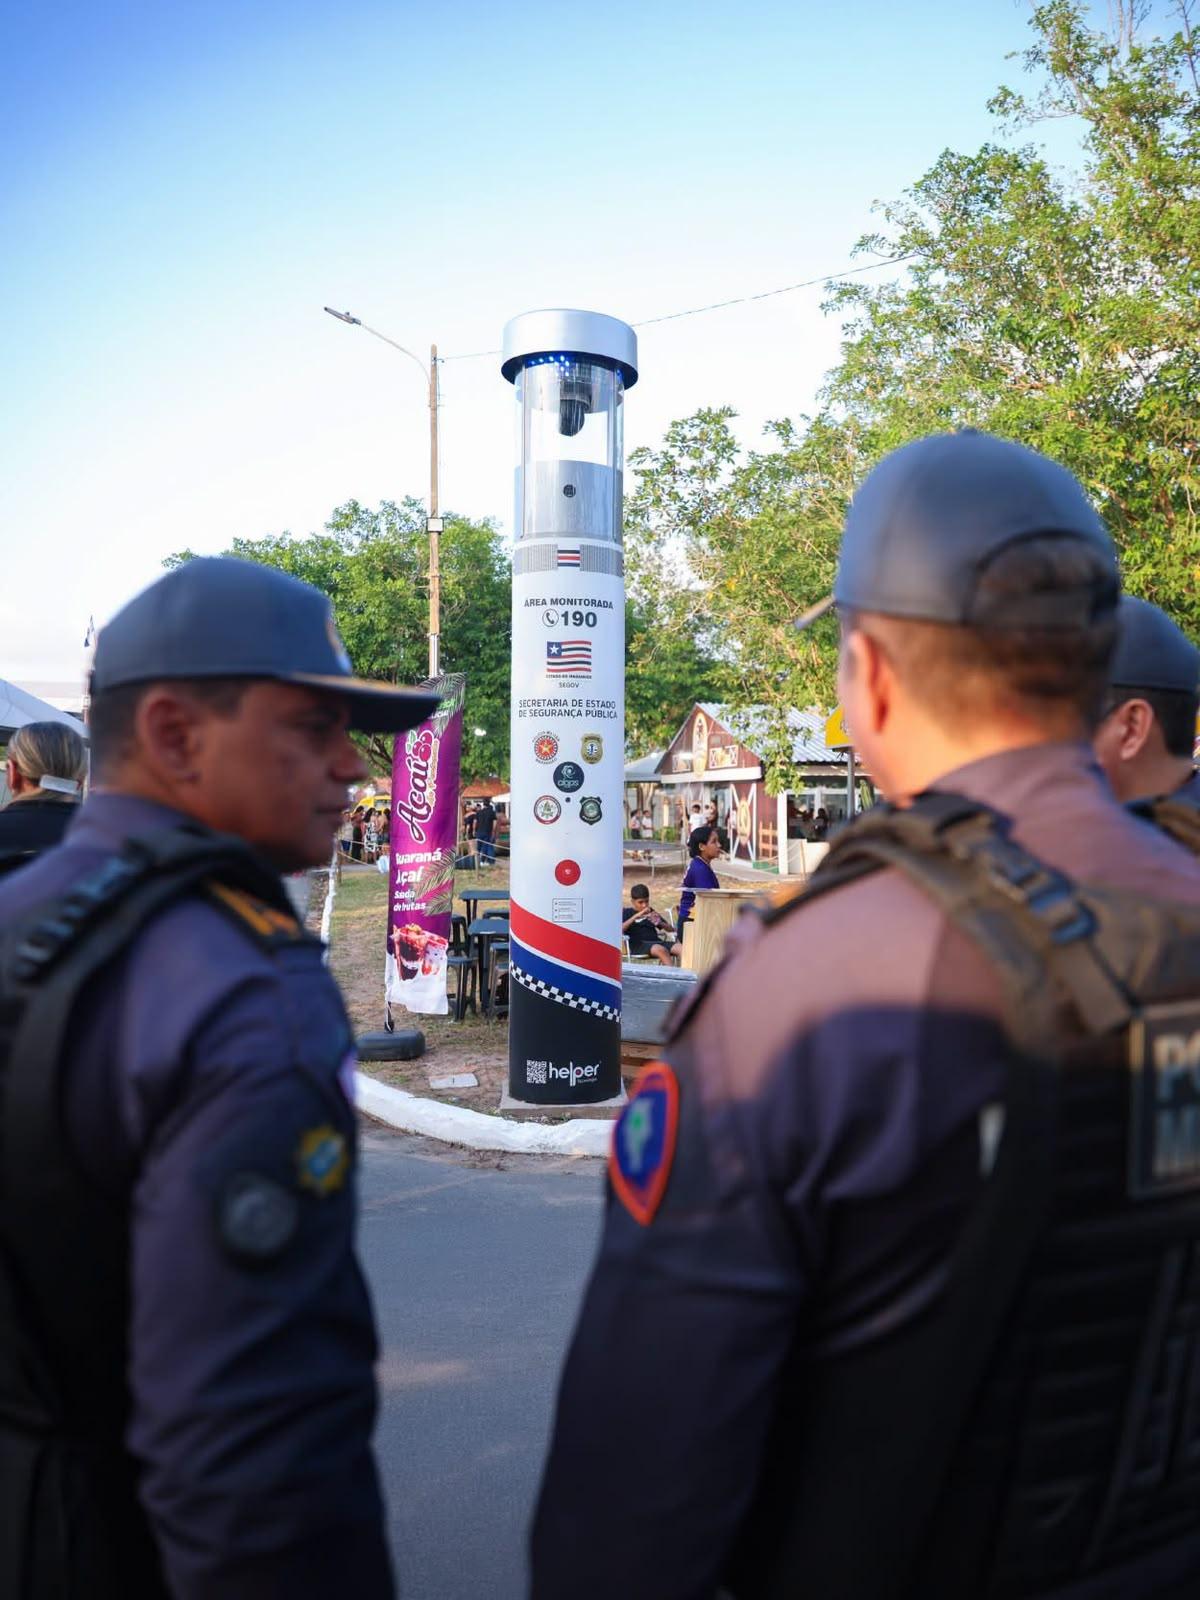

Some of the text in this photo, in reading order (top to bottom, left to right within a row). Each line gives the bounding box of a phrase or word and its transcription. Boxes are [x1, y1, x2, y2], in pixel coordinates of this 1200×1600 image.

[524, 597, 613, 609] ÁREA MONITORADA
[561, 610, 597, 628] 190
[519, 699, 616, 709] SECRETARIA DE ESTADO
[518, 707, 618, 719] DE SEGURANÇA PÚBLICA
[398, 756, 434, 843] Açaí
[549, 1061, 600, 1087] helper
